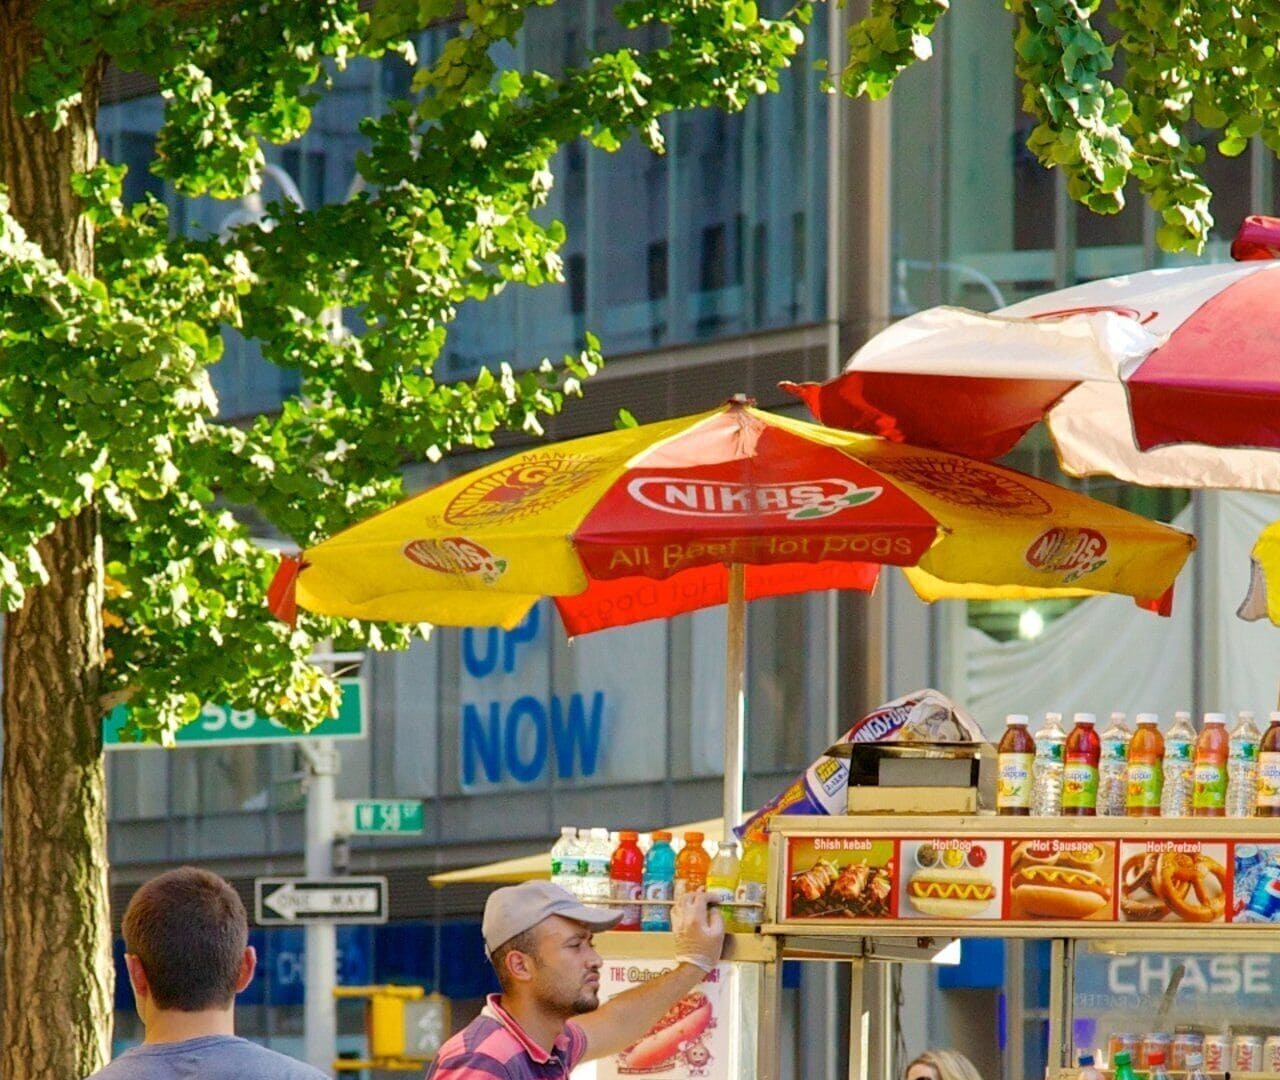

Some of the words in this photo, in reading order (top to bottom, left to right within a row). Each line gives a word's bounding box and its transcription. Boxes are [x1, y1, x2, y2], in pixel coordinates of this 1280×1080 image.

[665, 484, 826, 511] NIKAS
[609, 547, 650, 570] All
[664, 539, 741, 568] Beef
[824, 534, 912, 557] Dogs
[462, 690, 604, 786] NOW
[814, 839, 841, 850] Shish
[842, 839, 873, 850] kebab
[932, 839, 950, 850] Hot
[950, 840, 972, 852] Dog
[1032, 840, 1051, 851] Hot
[1052, 840, 1095, 853] Sausage
[1146, 841, 1166, 853] Hot
[1166, 842, 1202, 853] Pretzel
[610, 967, 626, 981] THE
[1107, 954, 1271, 994] CHASE
